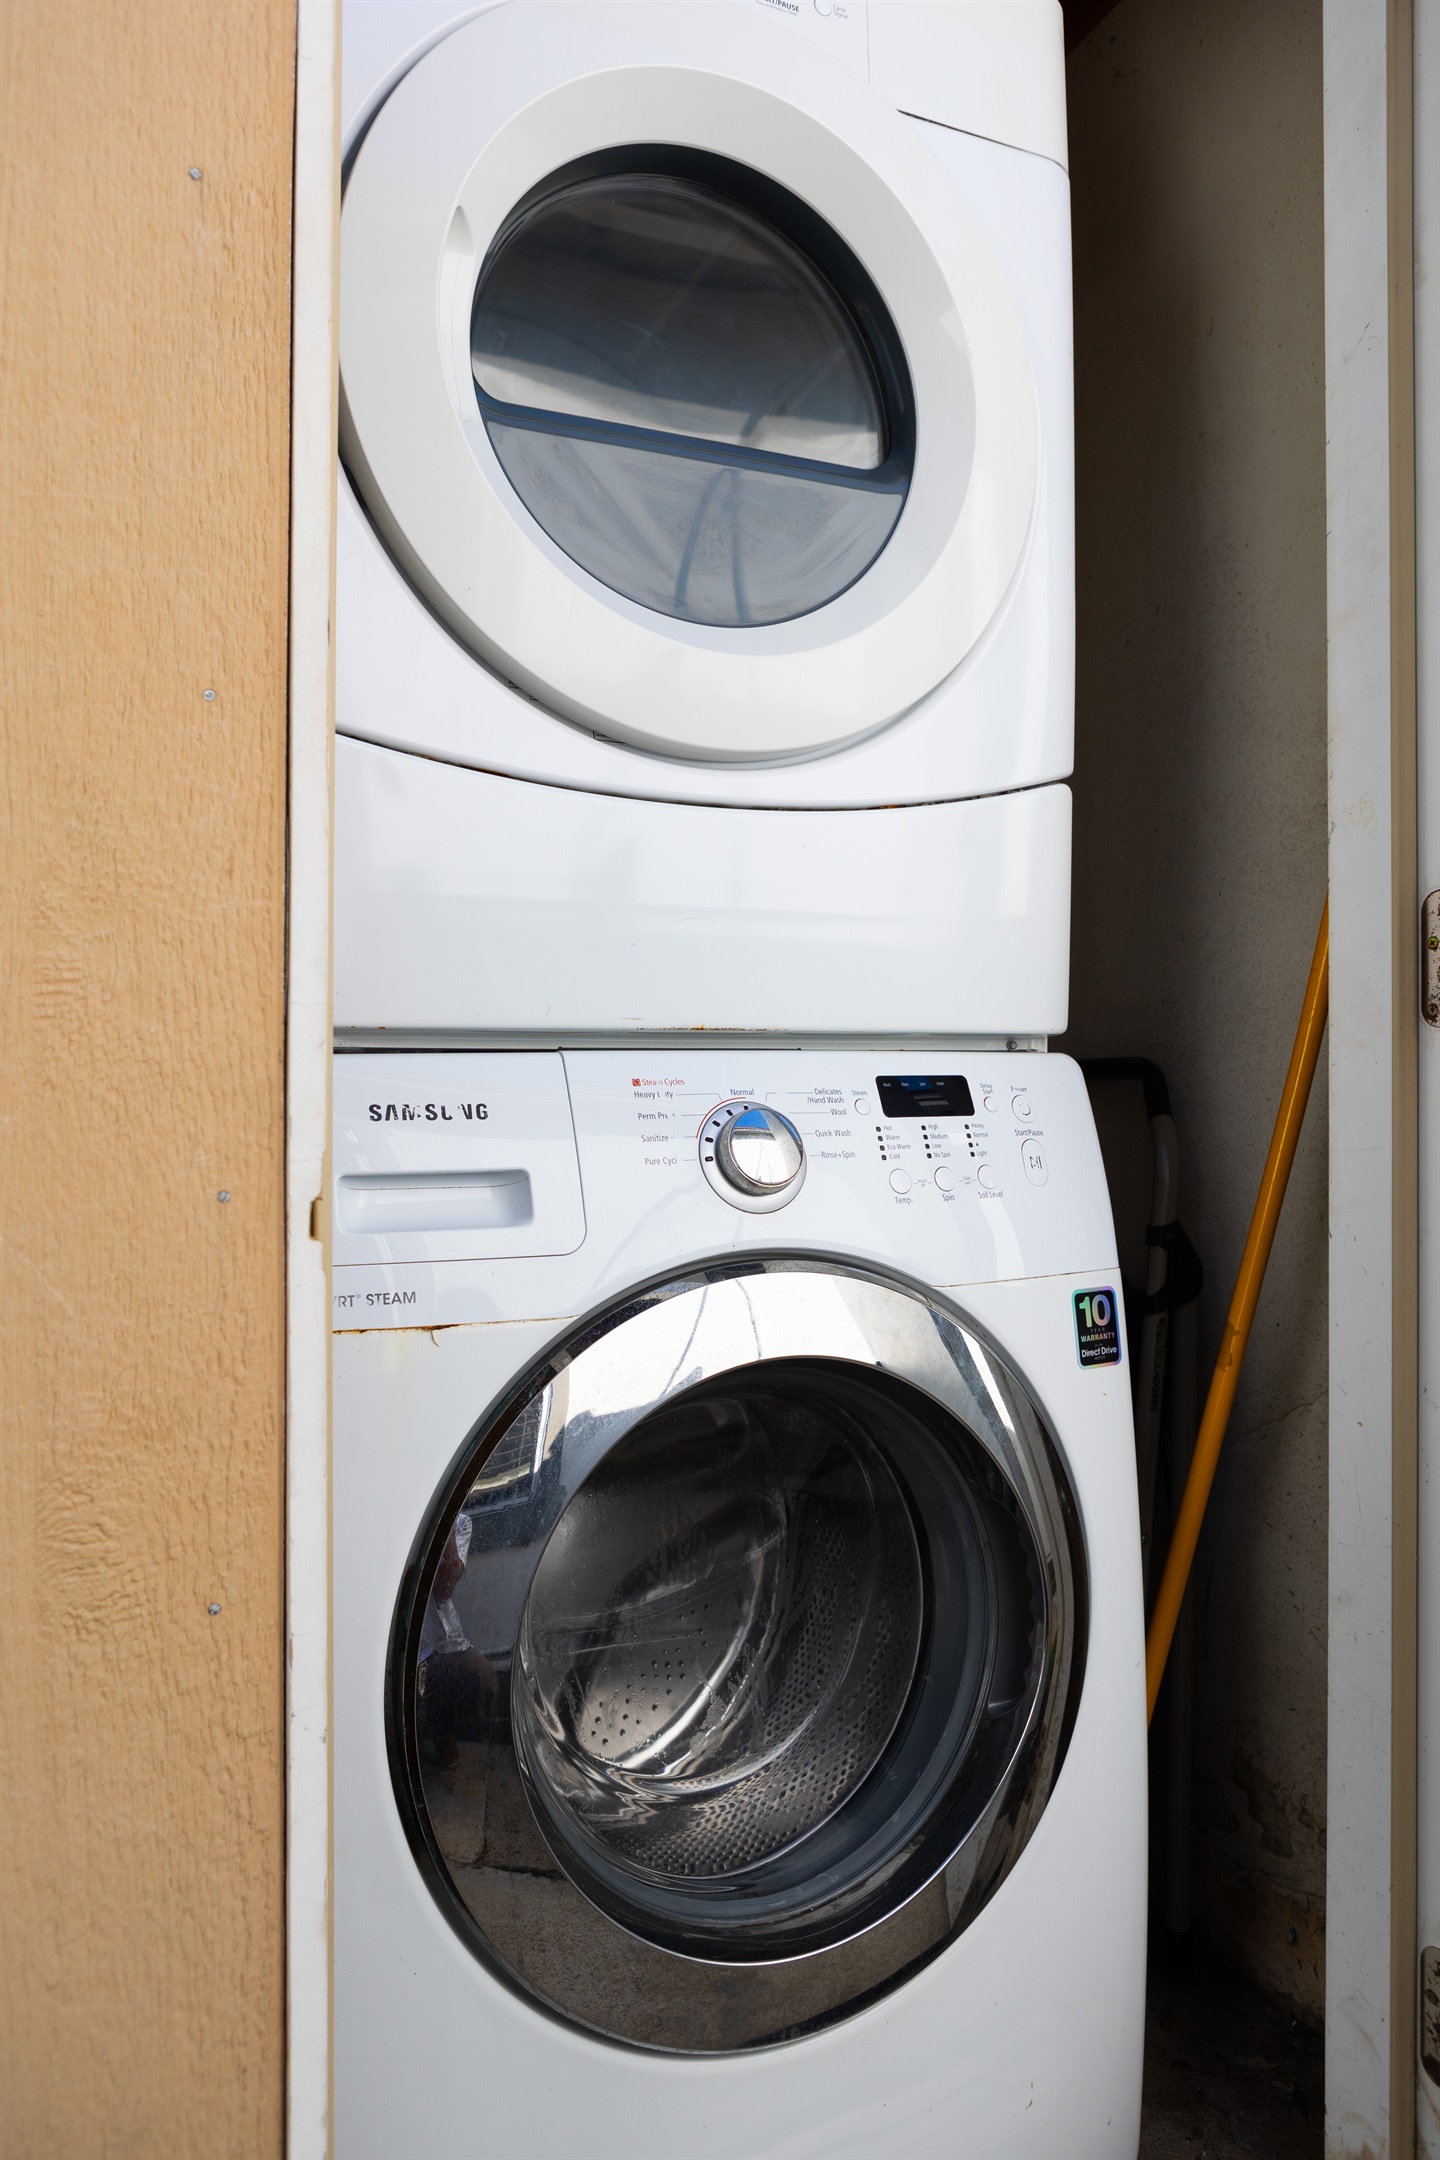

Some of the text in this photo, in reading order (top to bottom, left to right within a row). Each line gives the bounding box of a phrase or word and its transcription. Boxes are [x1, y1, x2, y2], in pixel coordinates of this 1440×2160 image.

[764, 0, 800, 12] RT/PAUSE
[833, 5, 846, 13] Cycle
[664, 1078, 685, 1087] Cycles
[634, 1091, 655, 1099] Heavy
[638, 1112, 656, 1120] Perm
[815, 1129, 832, 1137] Quick
[641, 1134, 668, 1142] Sanitize
[821, 1151, 855, 1159] Rinse+Spin
[662, 1157, 677, 1166] Cycl
[942, 1194, 955, 1202] Spin
[978, 1190, 1003, 1199] Soil Level
[895, 1197, 913, 1205] Temp.
[366, 1291, 416, 1306] STEAM
[1079, 1294, 1111, 1328] 10
[1080, 1331, 1115, 1342] WARRANTY
[1081, 1346, 1117, 1357] Direct Drive
